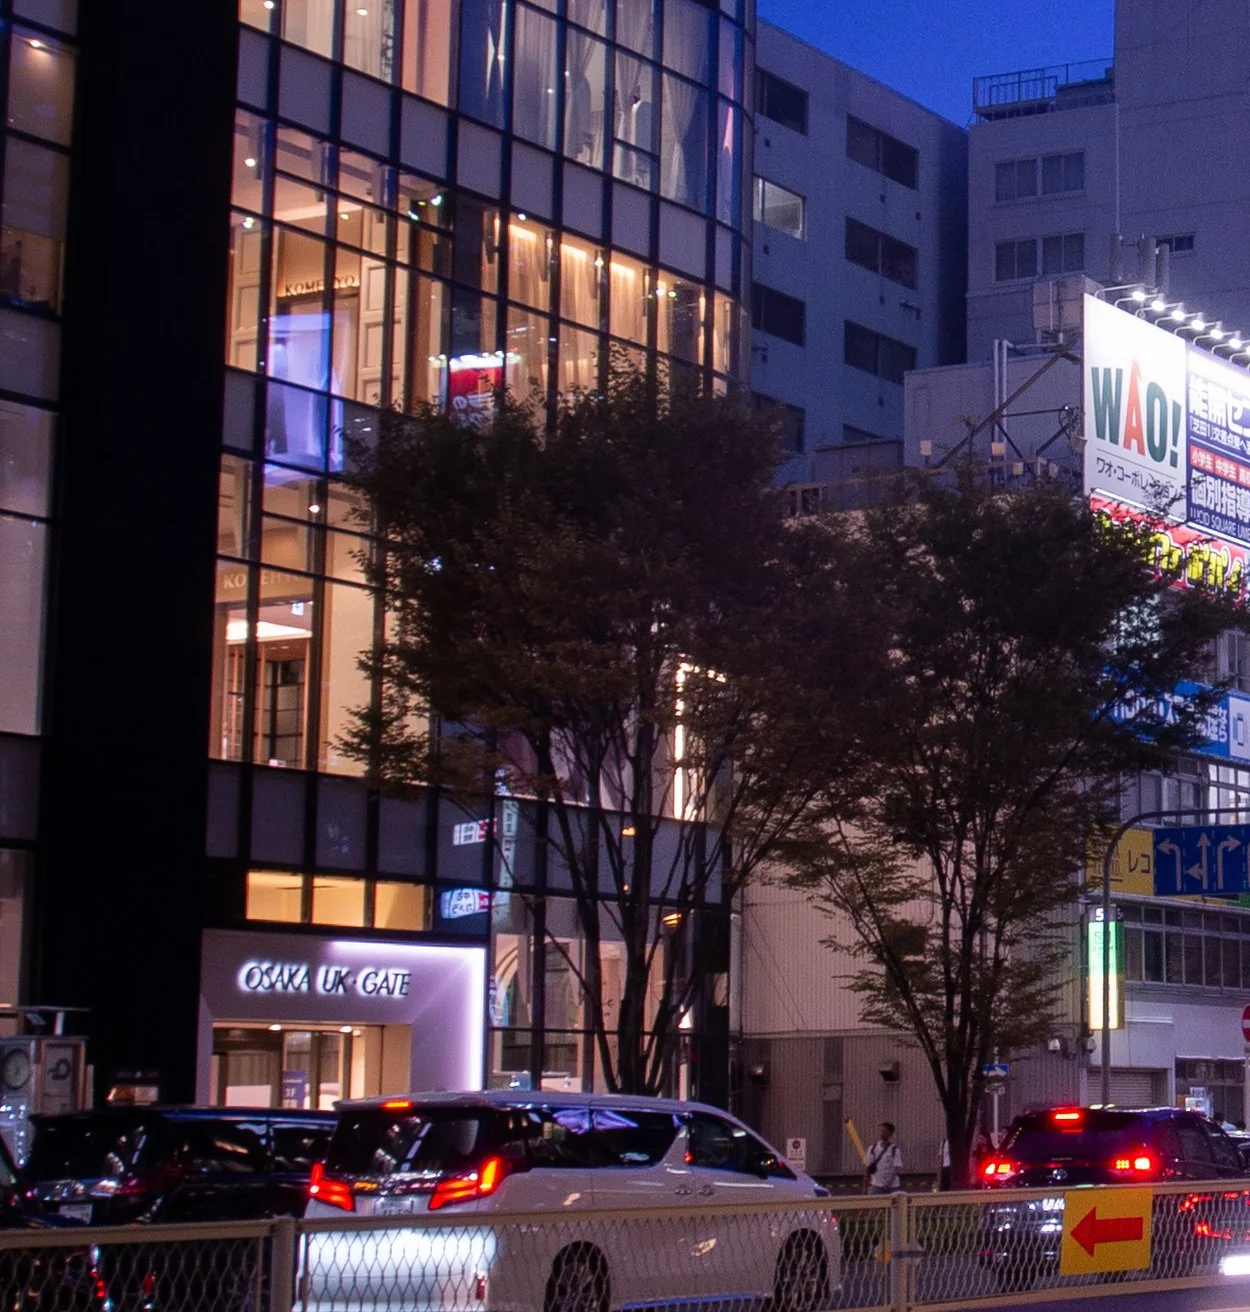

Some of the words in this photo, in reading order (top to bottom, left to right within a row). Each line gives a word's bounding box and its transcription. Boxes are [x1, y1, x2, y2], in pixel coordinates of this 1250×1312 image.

[284, 274, 355, 294] KOMEYO
[1091, 356, 1182, 468] WAO!
[245, 965, 311, 991] OSAKA
